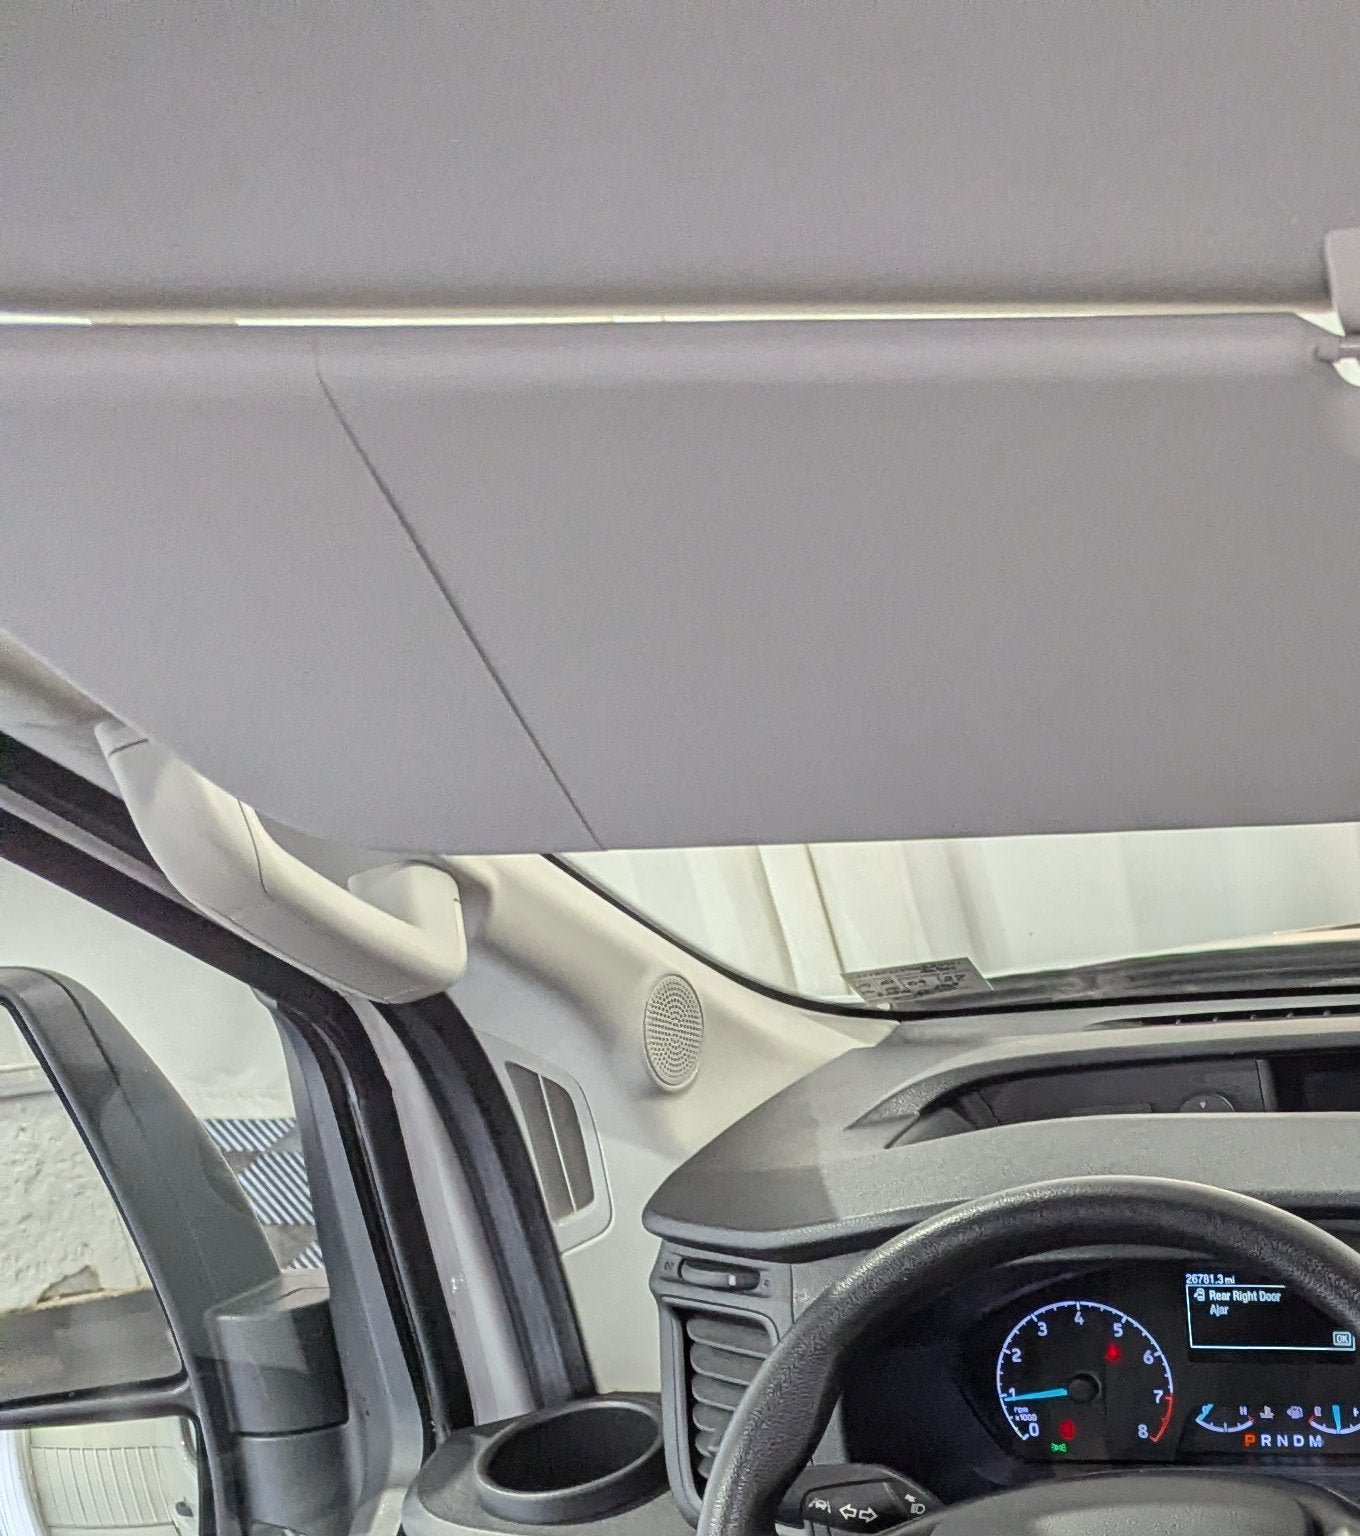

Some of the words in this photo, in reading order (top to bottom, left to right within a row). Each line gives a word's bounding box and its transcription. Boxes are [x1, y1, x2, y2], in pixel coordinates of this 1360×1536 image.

[1185, 1273, 1224, 1285] 26781.3
[1208, 1289, 1232, 1302] Rear
[1232, 1289, 1258, 1304] Right
[1258, 1289, 1282, 1303] Door
[1073, 1310, 1085, 1326] 4
[1209, 1303, 1230, 1317] Ajar
[1035, 1319, 1048, 1337] 3
[1113, 1320, 1126, 1338] 5
[1336, 1334, 1349, 1344] OK
[1009, 1347, 1022, 1363] 2
[1143, 1349, 1156, 1365] 6
[1153, 1389, 1164, 1404] 7
[1239, 1405, 1248, 1416] H
[1028, 1422, 1040, 1438] 0
[1137, 1423, 1149, 1439] 8
[1244, 1432, 1256, 1447] P
[1260, 1433, 1272, 1447] R
[1276, 1434, 1289, 1448] N
[1292, 1434, 1305, 1448] D
[1308, 1434, 1324, 1448] M
